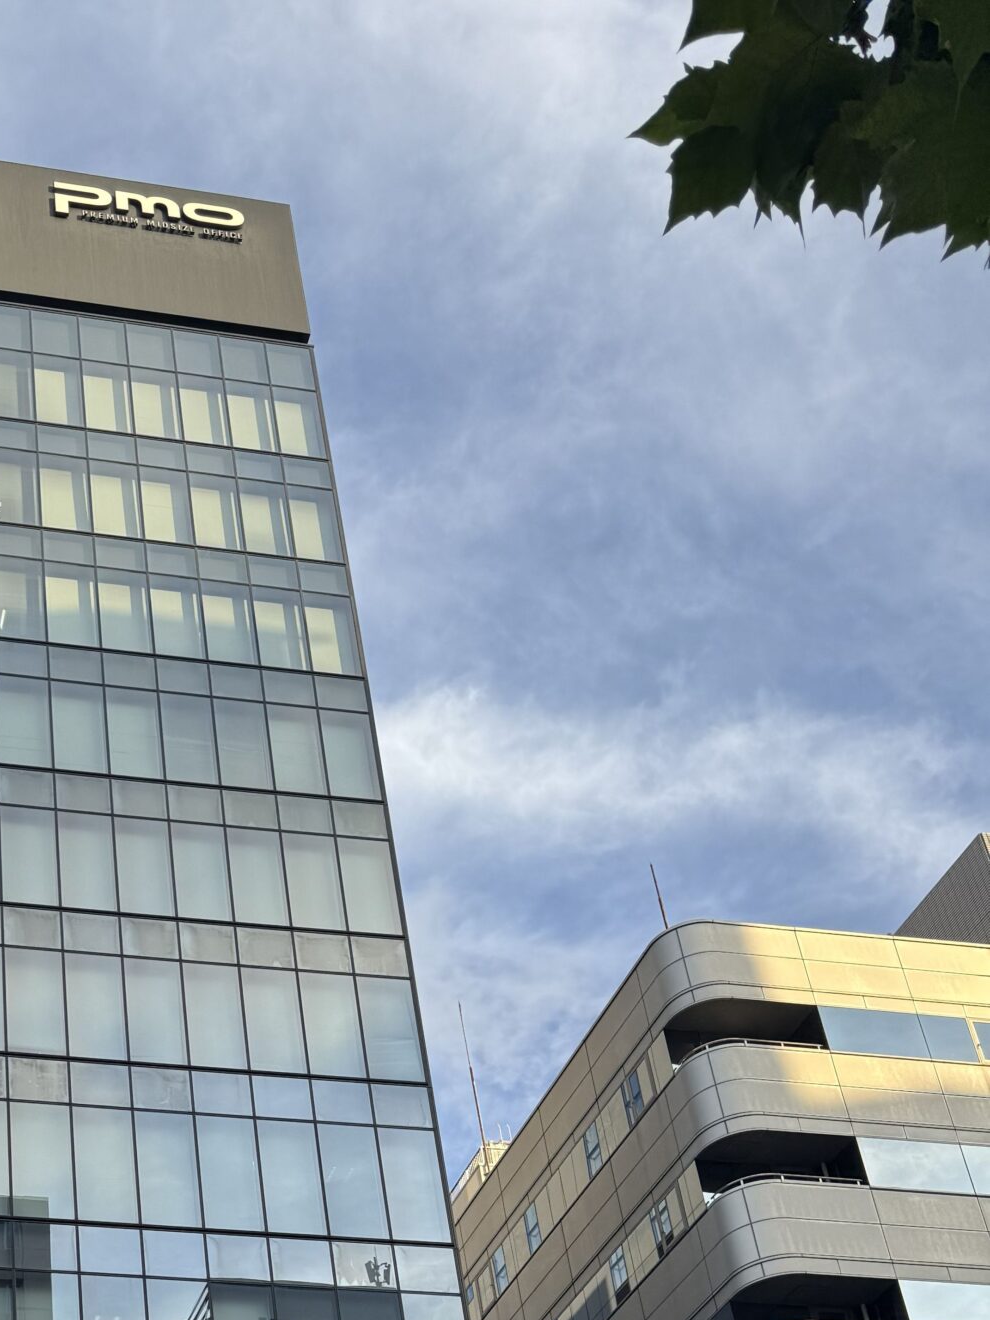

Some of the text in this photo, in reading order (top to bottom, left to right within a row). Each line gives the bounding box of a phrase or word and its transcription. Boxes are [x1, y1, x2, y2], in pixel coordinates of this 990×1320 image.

[81, 209, 243, 240] PREMIUM MIDSIZE OFFICE
